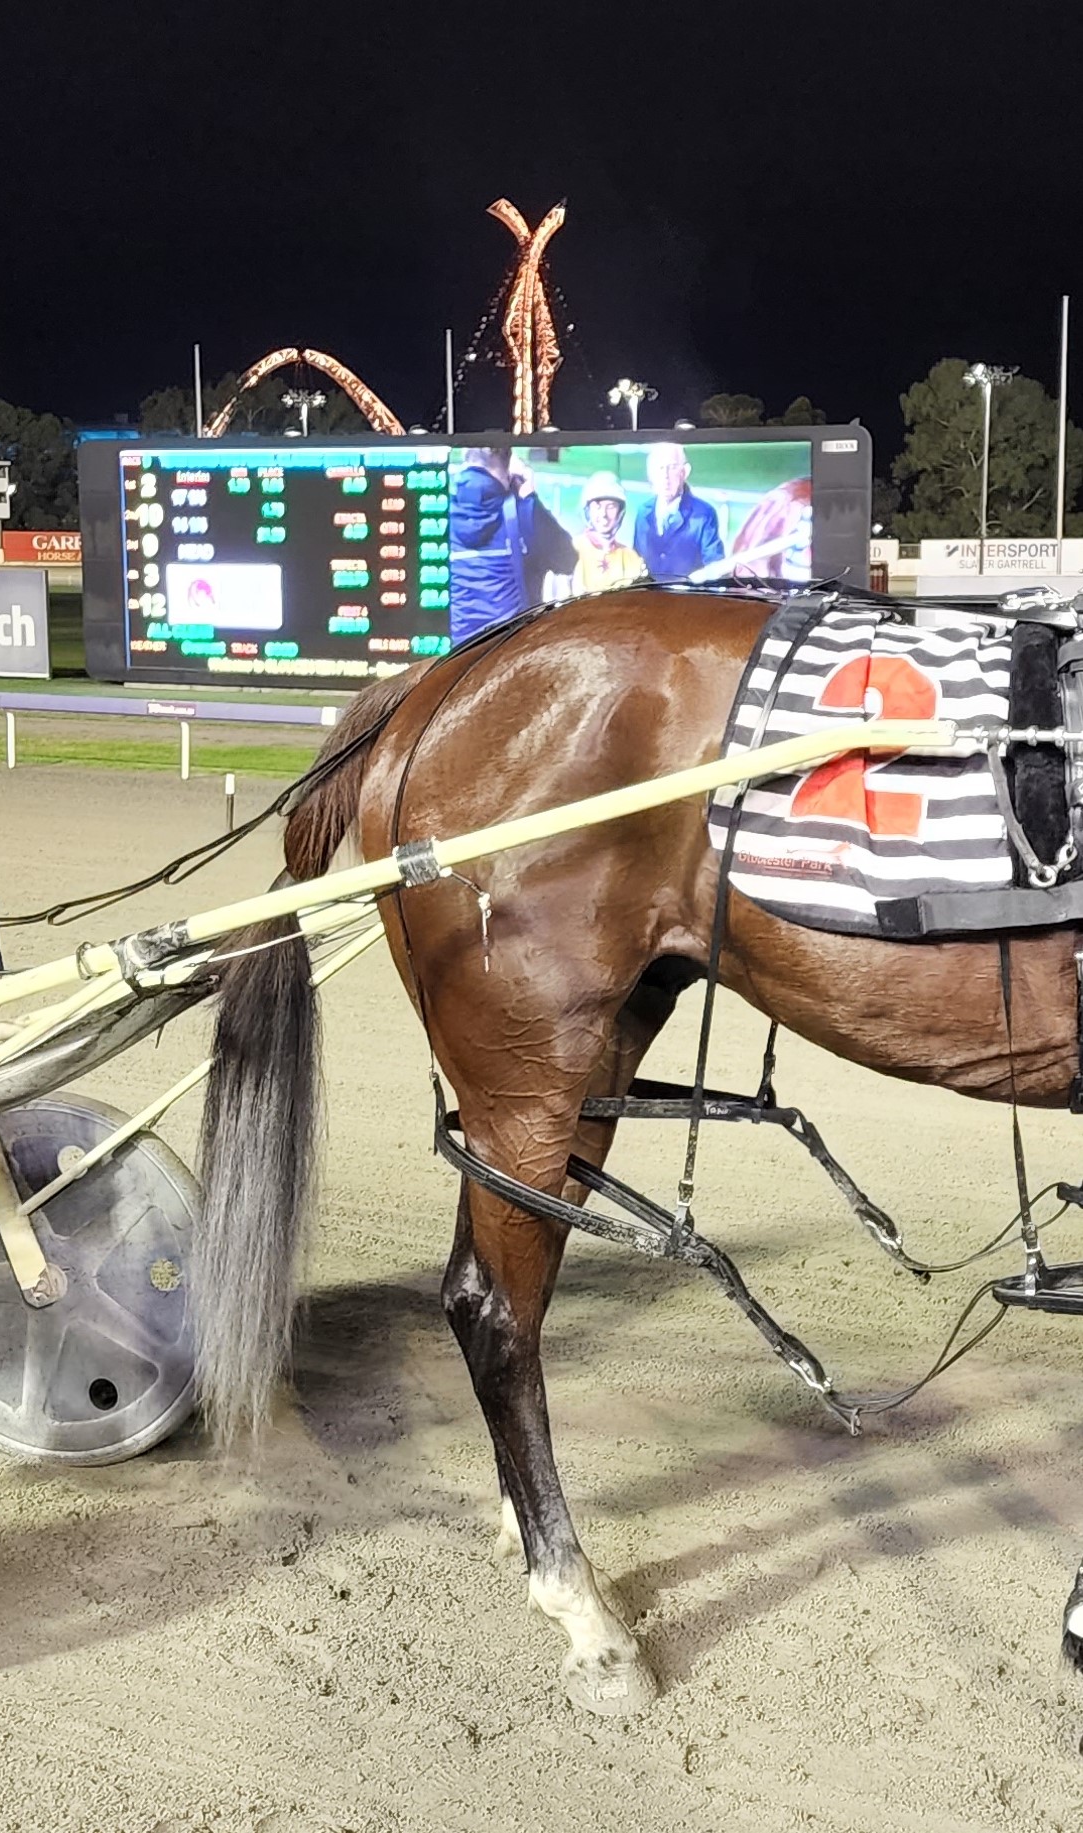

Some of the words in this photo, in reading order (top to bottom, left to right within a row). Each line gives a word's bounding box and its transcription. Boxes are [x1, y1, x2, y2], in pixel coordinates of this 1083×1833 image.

[141, 473, 157, 498] 2
[137, 503, 163, 528] 10
[37, 551, 75, 561] HORSE
[961, 542, 1058, 558] INTERSPORT
[143, 563, 159, 587] 3
[959, 560, 995, 570] SLAER
[997, 560, 1047, 570] GARTRELL
[139, 593, 167, 617] 12
[788, 654, 939, 841] 2
[800, 857, 834, 872] Park
